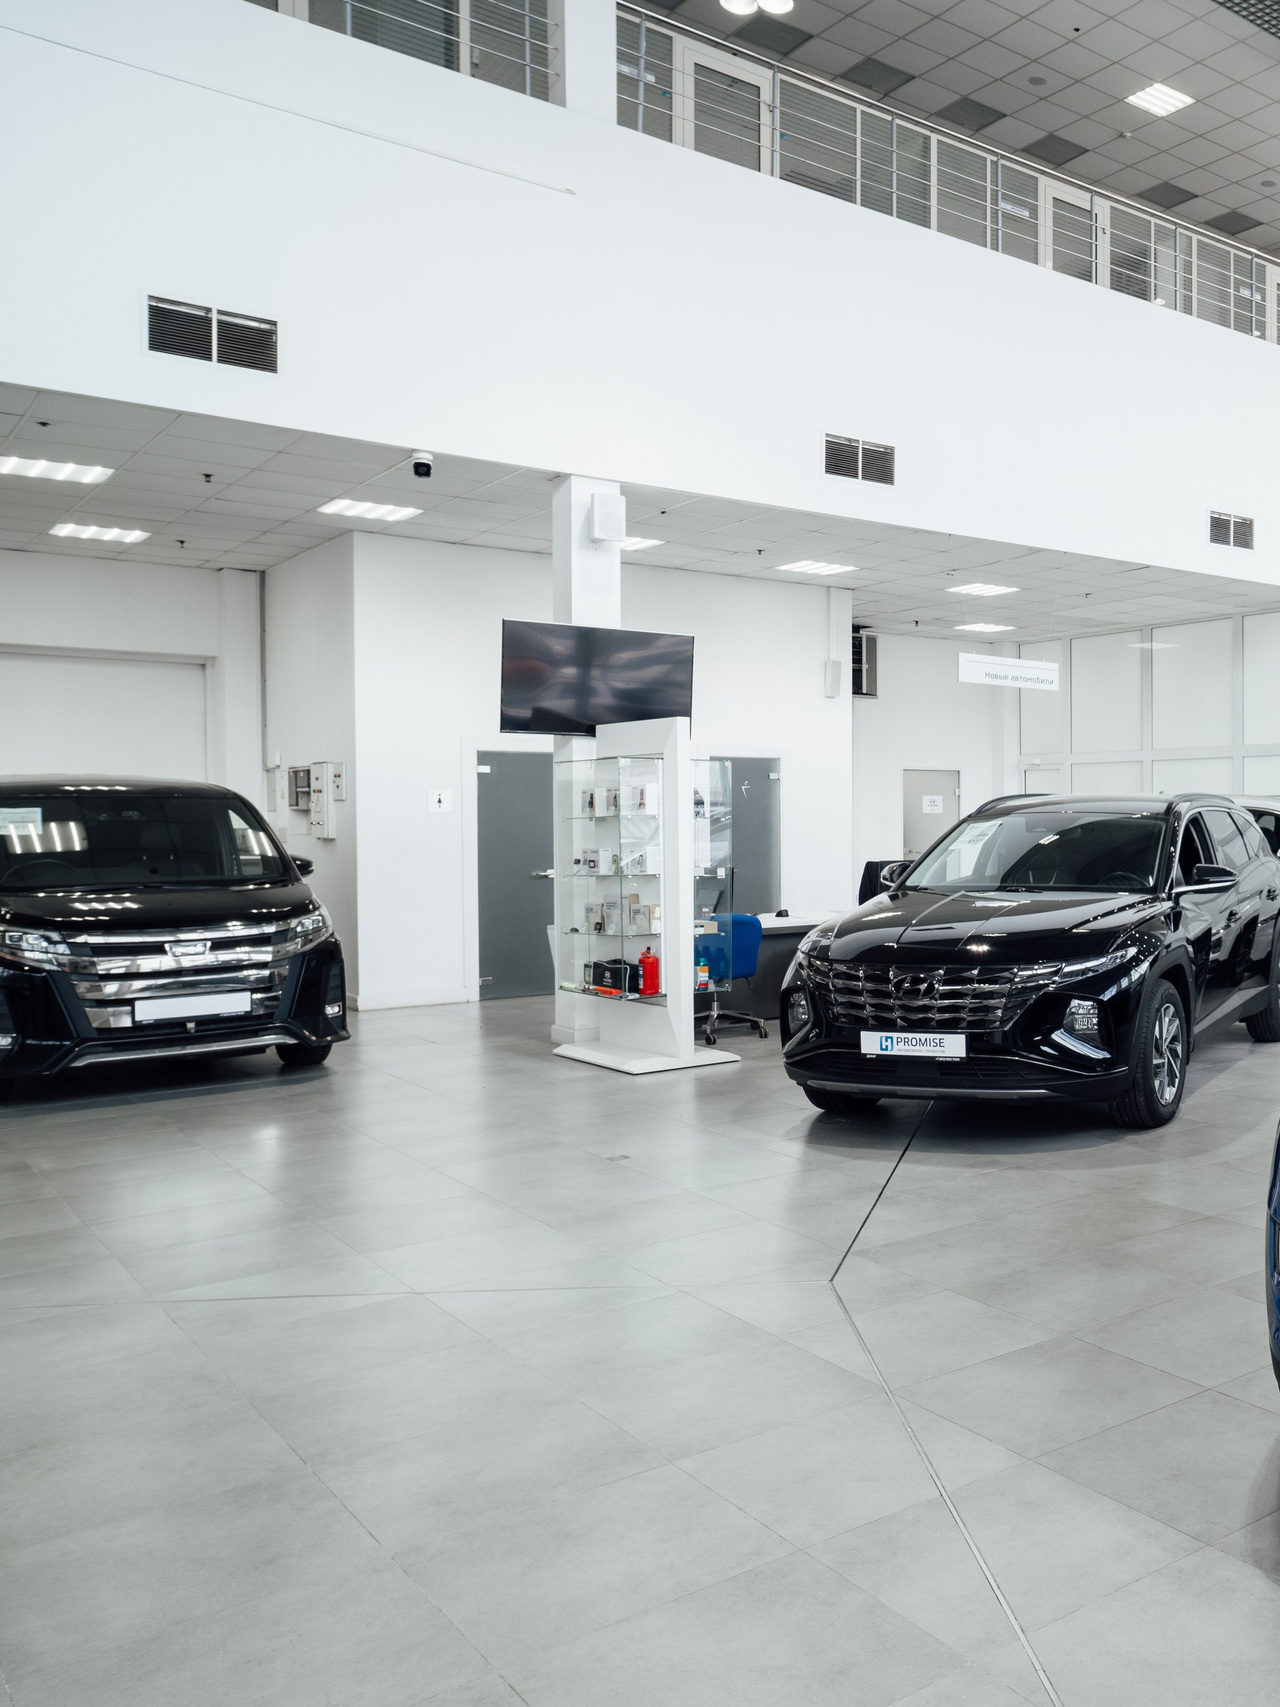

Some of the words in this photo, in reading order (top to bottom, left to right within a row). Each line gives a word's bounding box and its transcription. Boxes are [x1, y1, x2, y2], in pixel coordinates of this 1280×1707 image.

[985, 671, 1009, 681] Новые
[1011, 675, 1054, 685] автомобили
[896, 1036, 945, 1048] PROMISE
